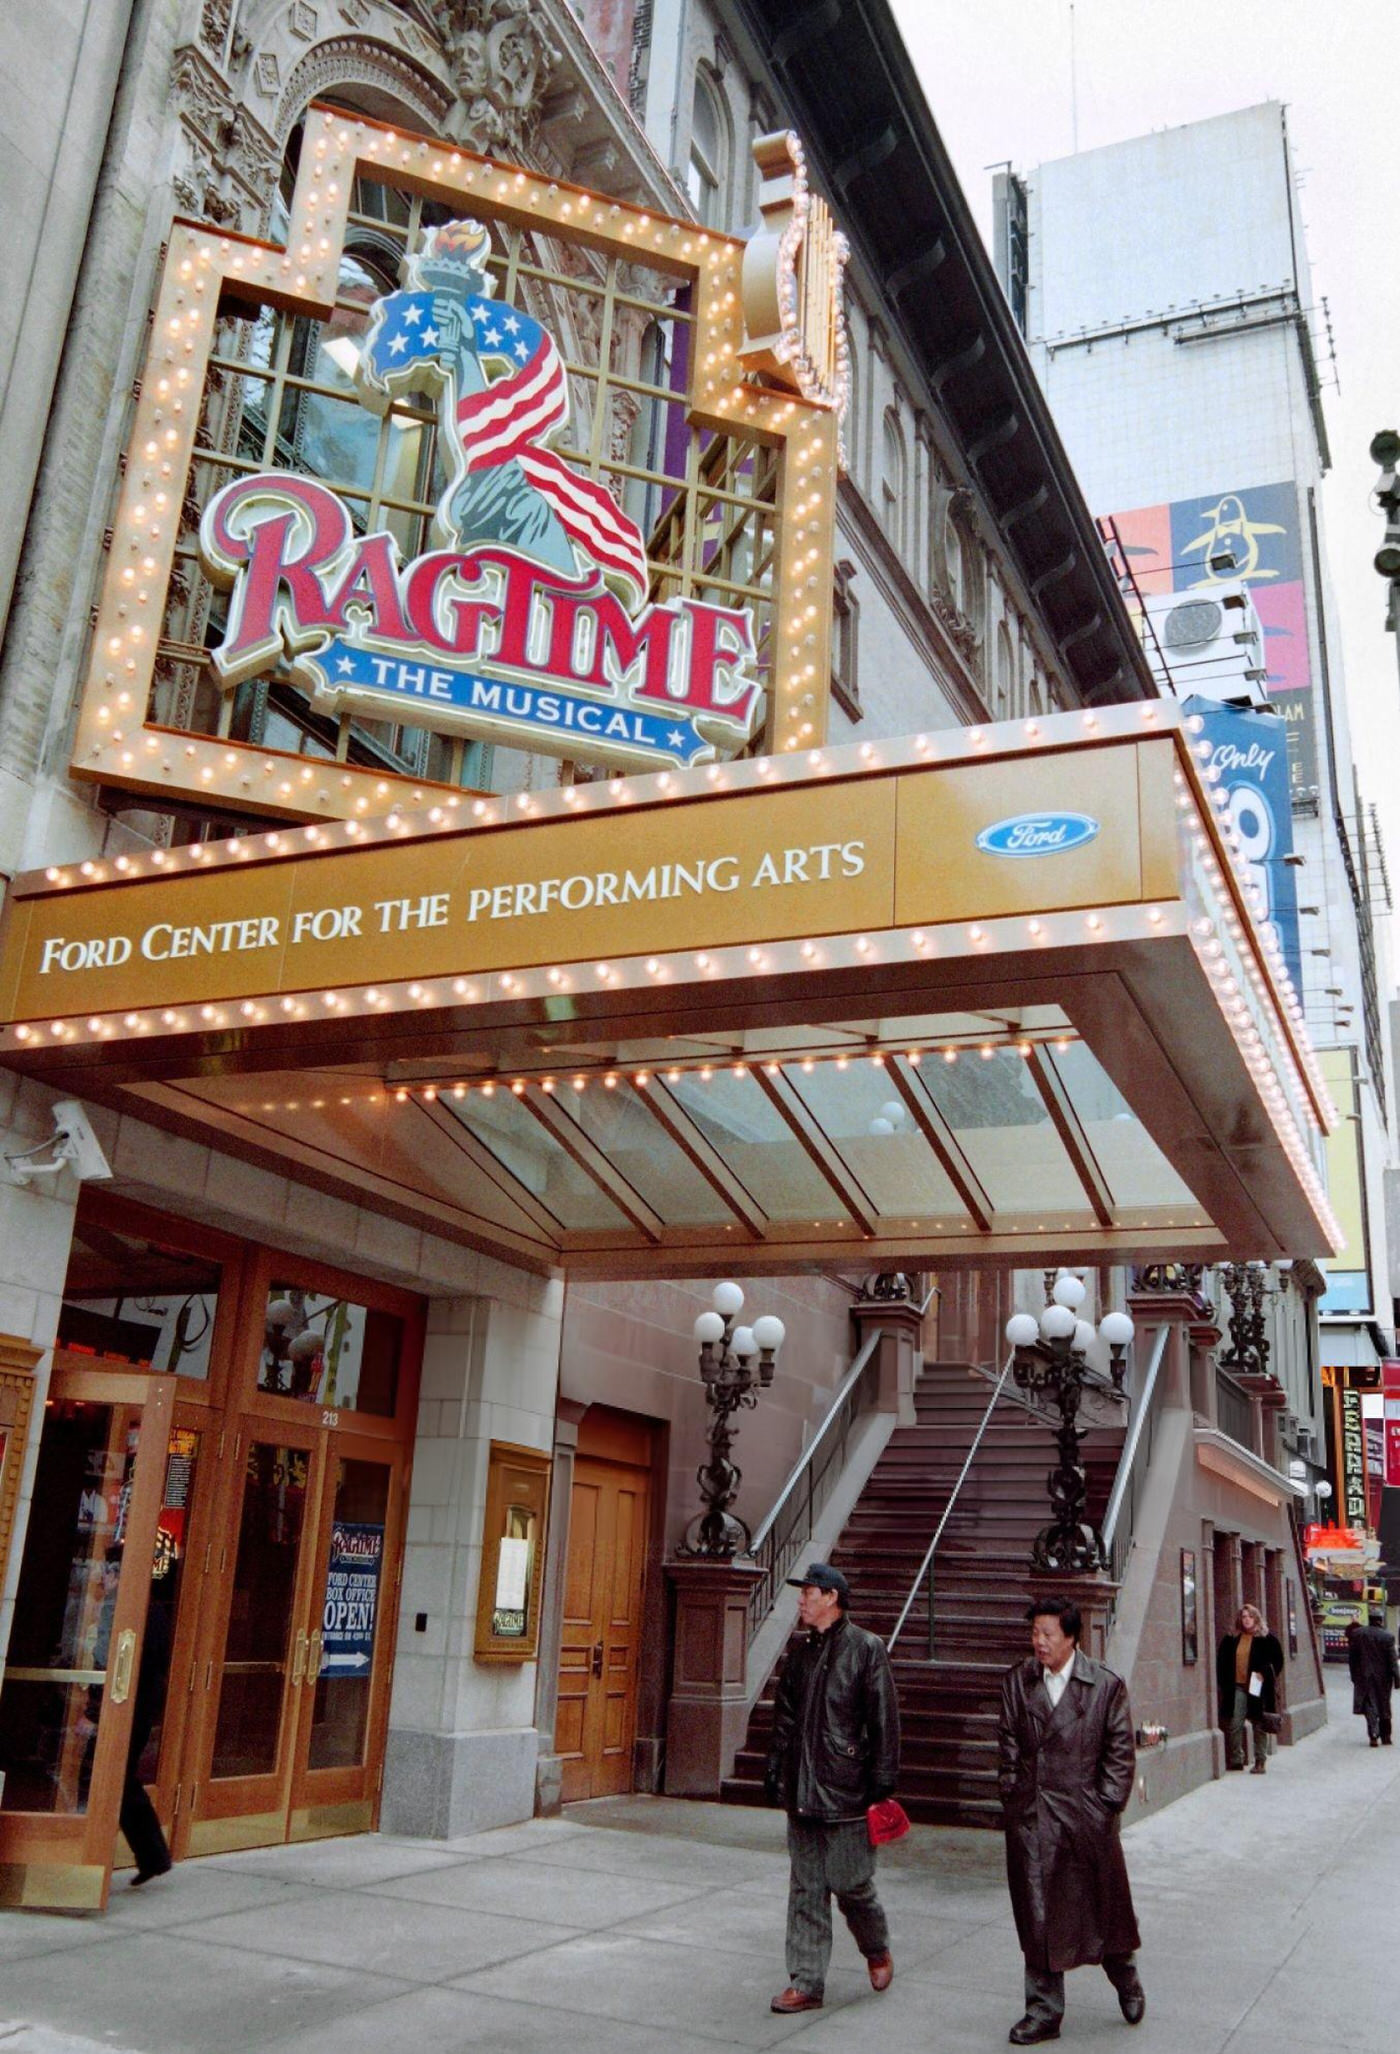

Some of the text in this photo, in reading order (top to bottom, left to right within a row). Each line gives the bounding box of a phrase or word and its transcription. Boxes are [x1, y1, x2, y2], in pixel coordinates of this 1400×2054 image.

[214, 476, 754, 722] RAGTIME
[371, 656, 656, 745] THE MUSICAL
[1211, 743, 1275, 781] Only
[1006, 821, 1067, 849] Ford
[39, 840, 865, 974] FORD CENTER FOR THE PERFORMING ARTS
[322, 1410, 339, 1427] 213
[326, 1587, 376, 1602] BOX OFFICE
[327, 1573, 377, 1588] FORD CENTER
[324, 1602, 374, 1631] OPEN!
